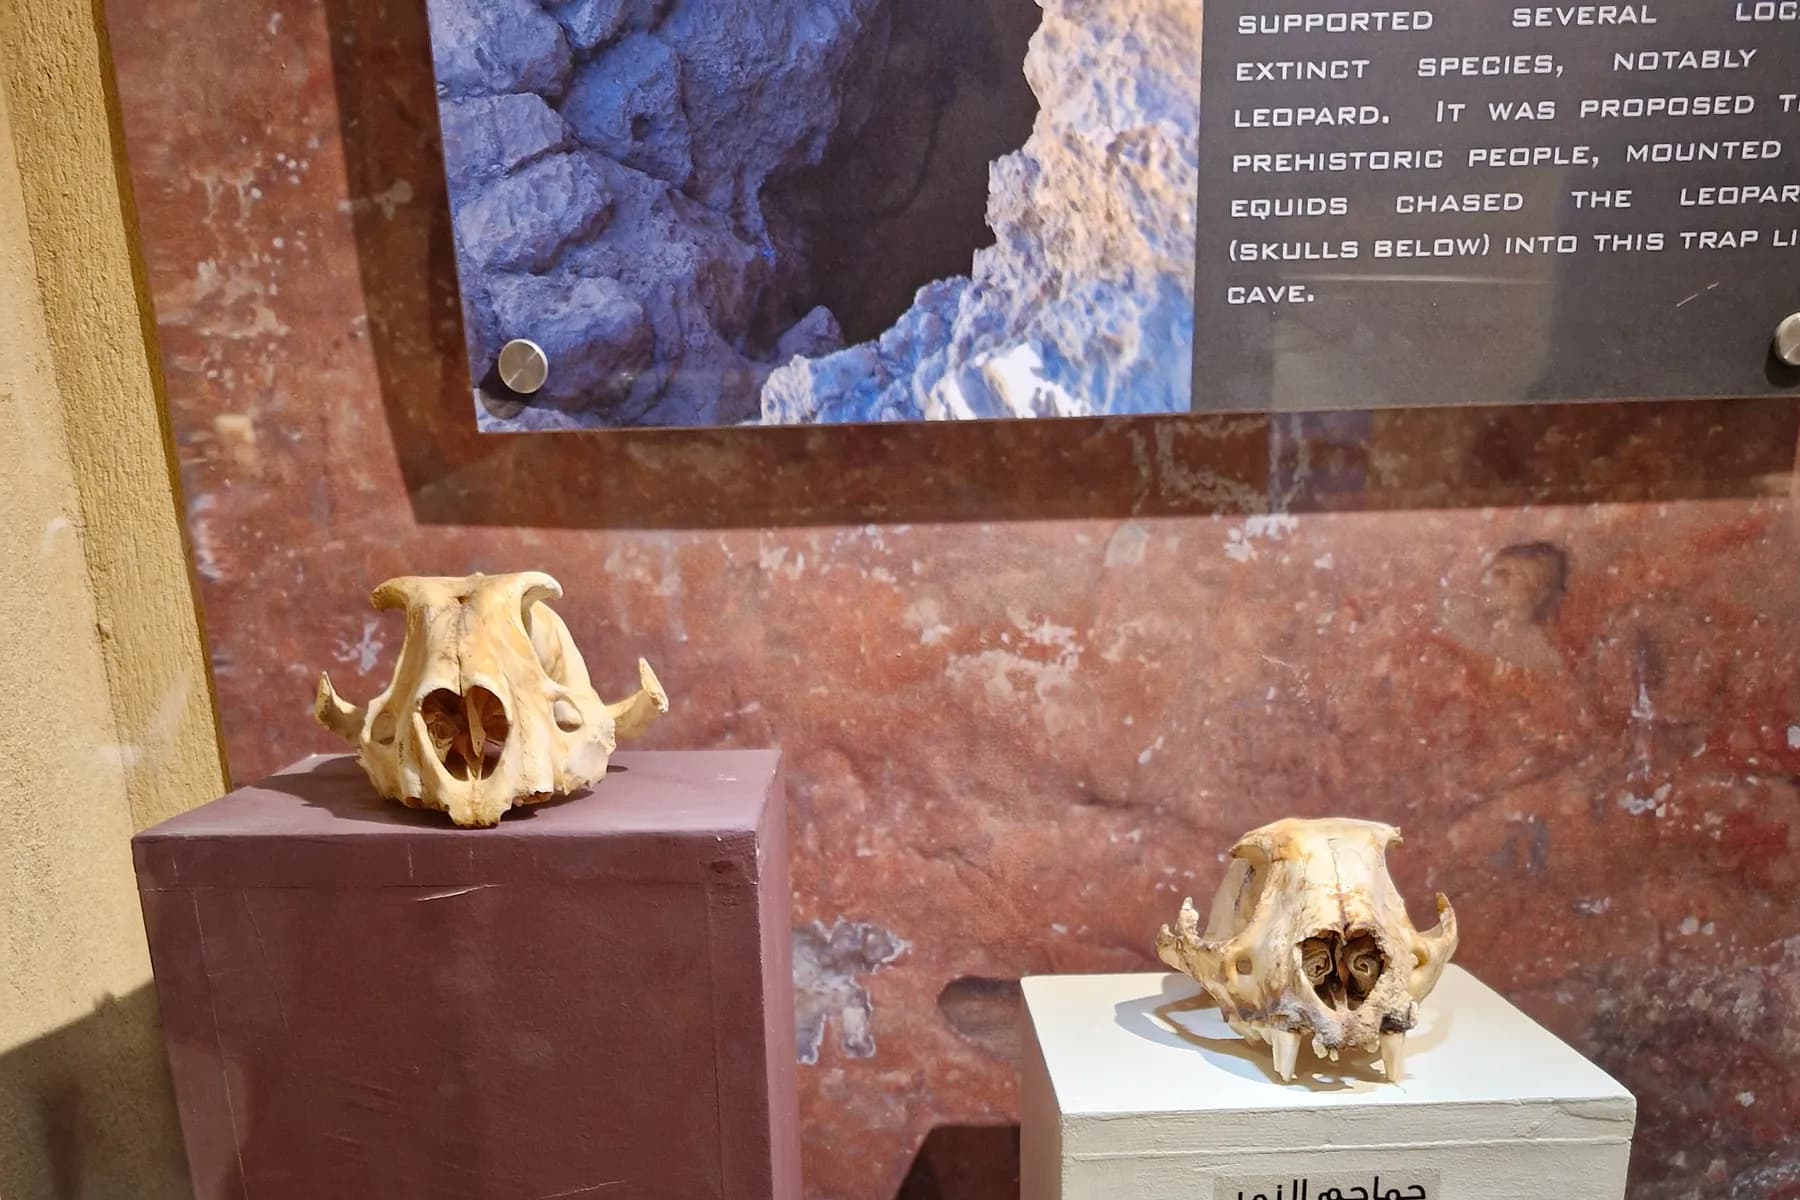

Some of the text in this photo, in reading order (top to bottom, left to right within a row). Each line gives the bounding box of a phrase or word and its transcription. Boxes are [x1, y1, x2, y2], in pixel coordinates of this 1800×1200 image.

[1239, 2, 1800, 33] SUPPORTED SEVERAL LOC
[1237, 49, 1756, 81] EXTINCT SPECIES, NOTABLY
[1235, 95, 1800, 127] LEOPARD. IT WAS PROPOSED T
[1233, 141, 1781, 172] PREHISTORIC PEOPLE, MOUNTED
[1232, 198, 1347, 219] EQUIDS
[1397, 193, 1523, 213] CHASED
[1572, 190, 1632, 208] THE
[1230, 240, 1358, 261] (SKULLS
[1375, 234, 1489, 257] BELOW)
[1506, 236, 1577, 253] INTO
[1594, 233, 1663, 251] THIS
[1680, 231, 1758, 249] TRAP
[1228, 286, 1313, 303] CAVE.
